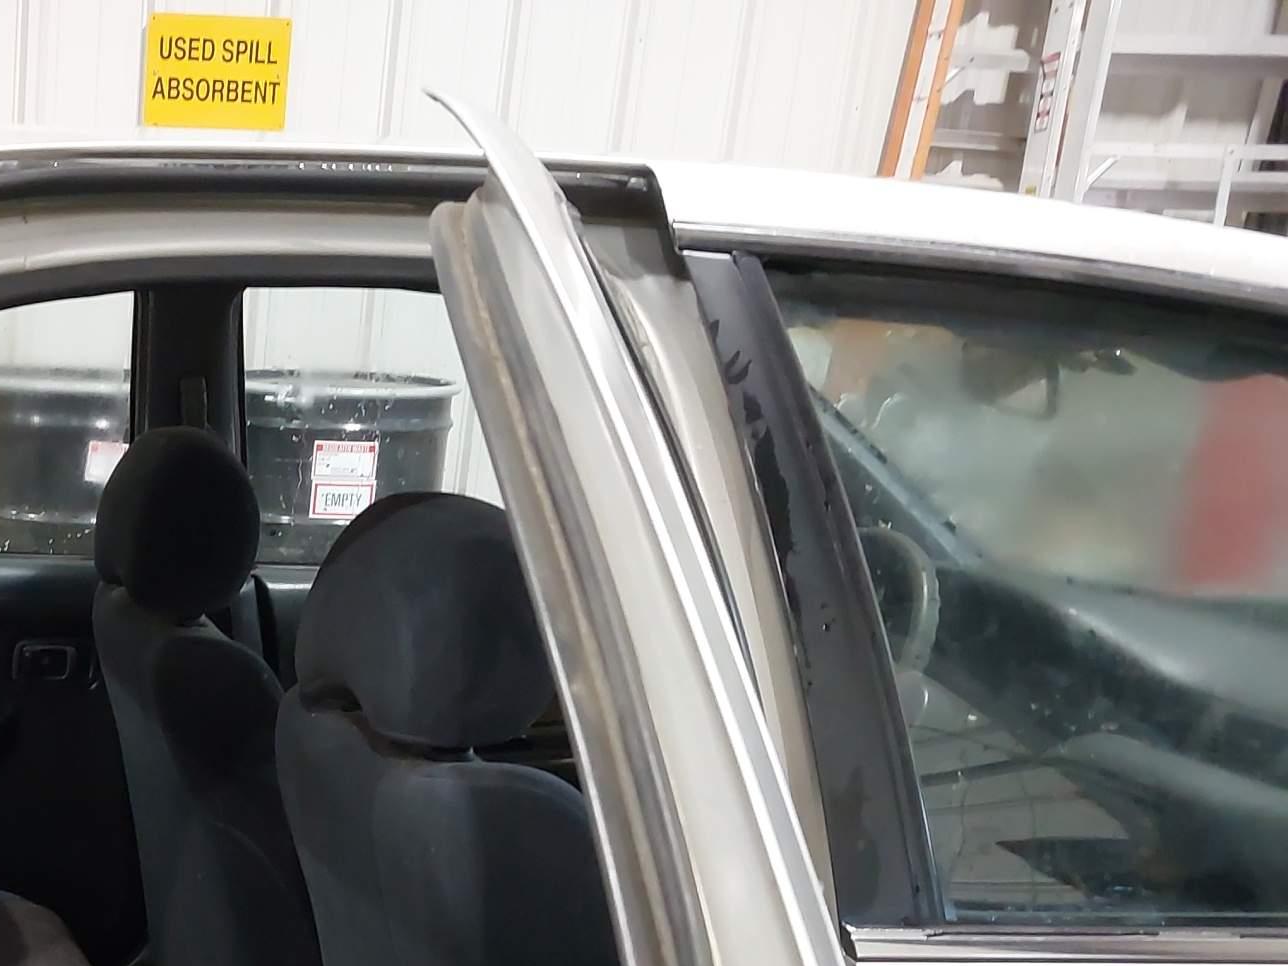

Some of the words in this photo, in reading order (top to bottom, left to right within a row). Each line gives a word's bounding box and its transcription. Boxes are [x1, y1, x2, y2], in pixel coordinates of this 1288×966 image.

[159, 36, 215, 62] USED
[222, 38, 278, 65] SPILL
[152, 76, 281, 105] ABSORBENT
[324, 492, 362, 508] EMPTY
